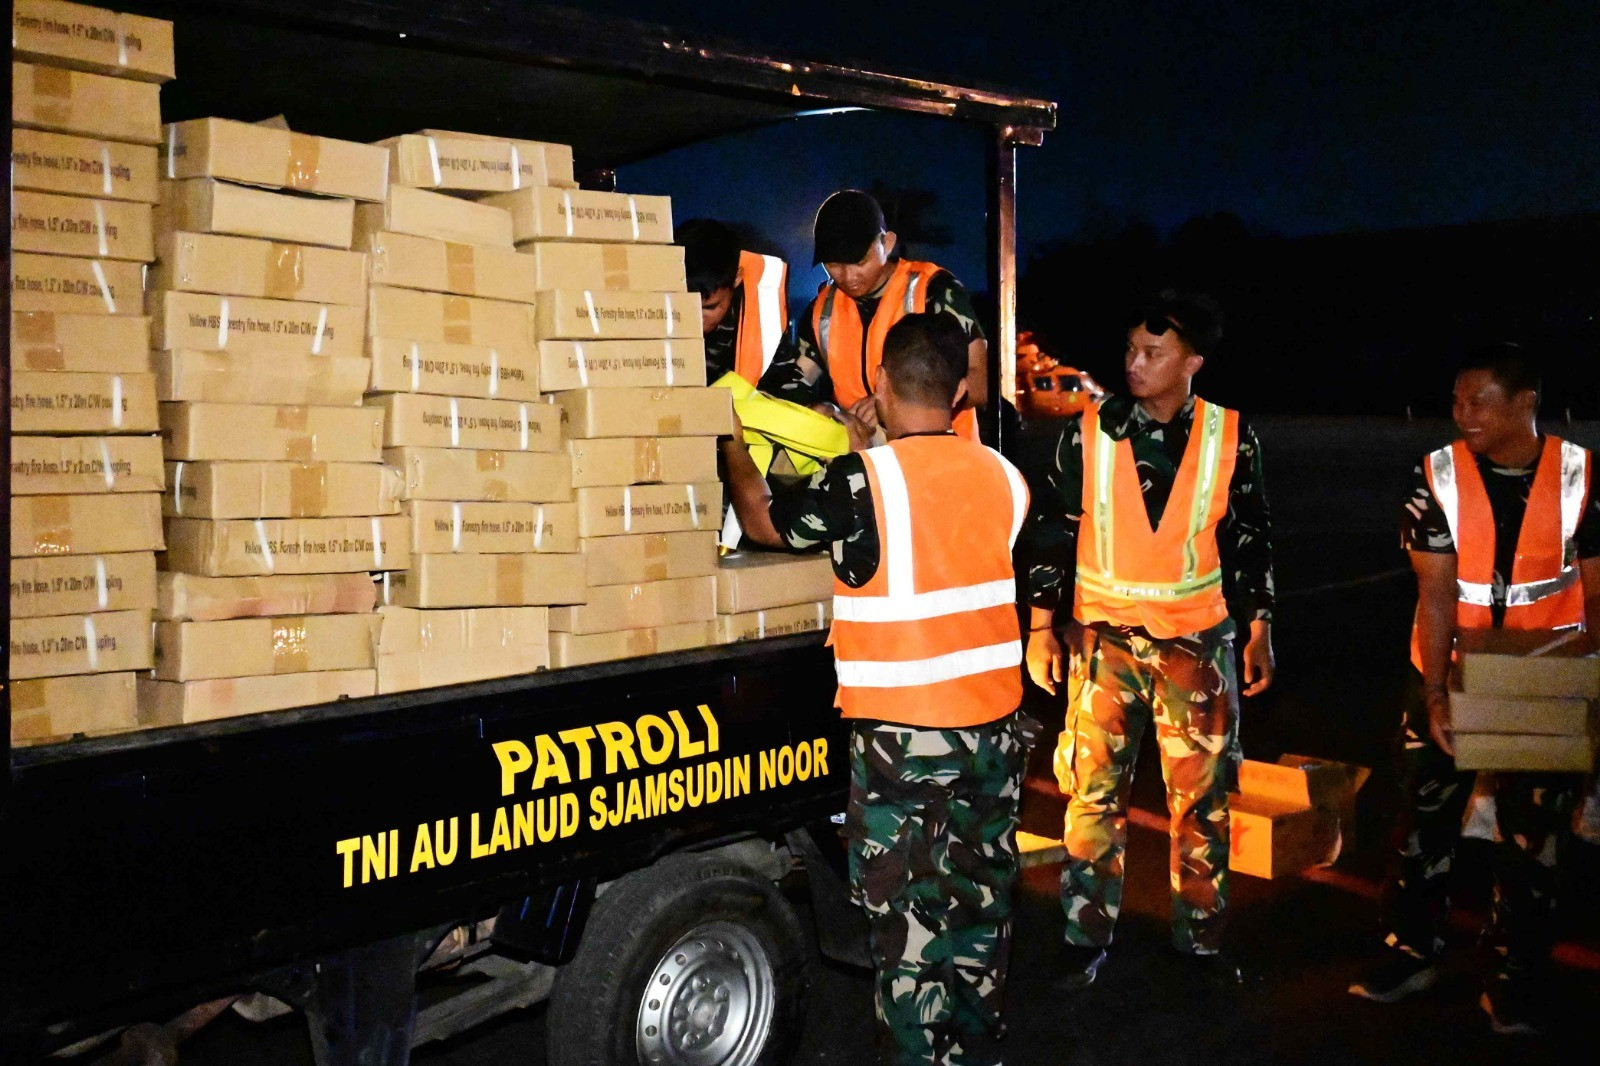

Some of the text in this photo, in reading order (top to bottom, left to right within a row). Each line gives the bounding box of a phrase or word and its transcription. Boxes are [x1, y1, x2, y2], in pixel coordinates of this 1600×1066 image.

[188, 312, 207, 328] Yellow
[280, 540, 301, 557] Forestry
[304, 540, 312, 553] fire
[492, 705, 719, 796] PATROLI
[337, 737, 829, 888] TNI AU LANUD SJAMSUDIN NOOR
